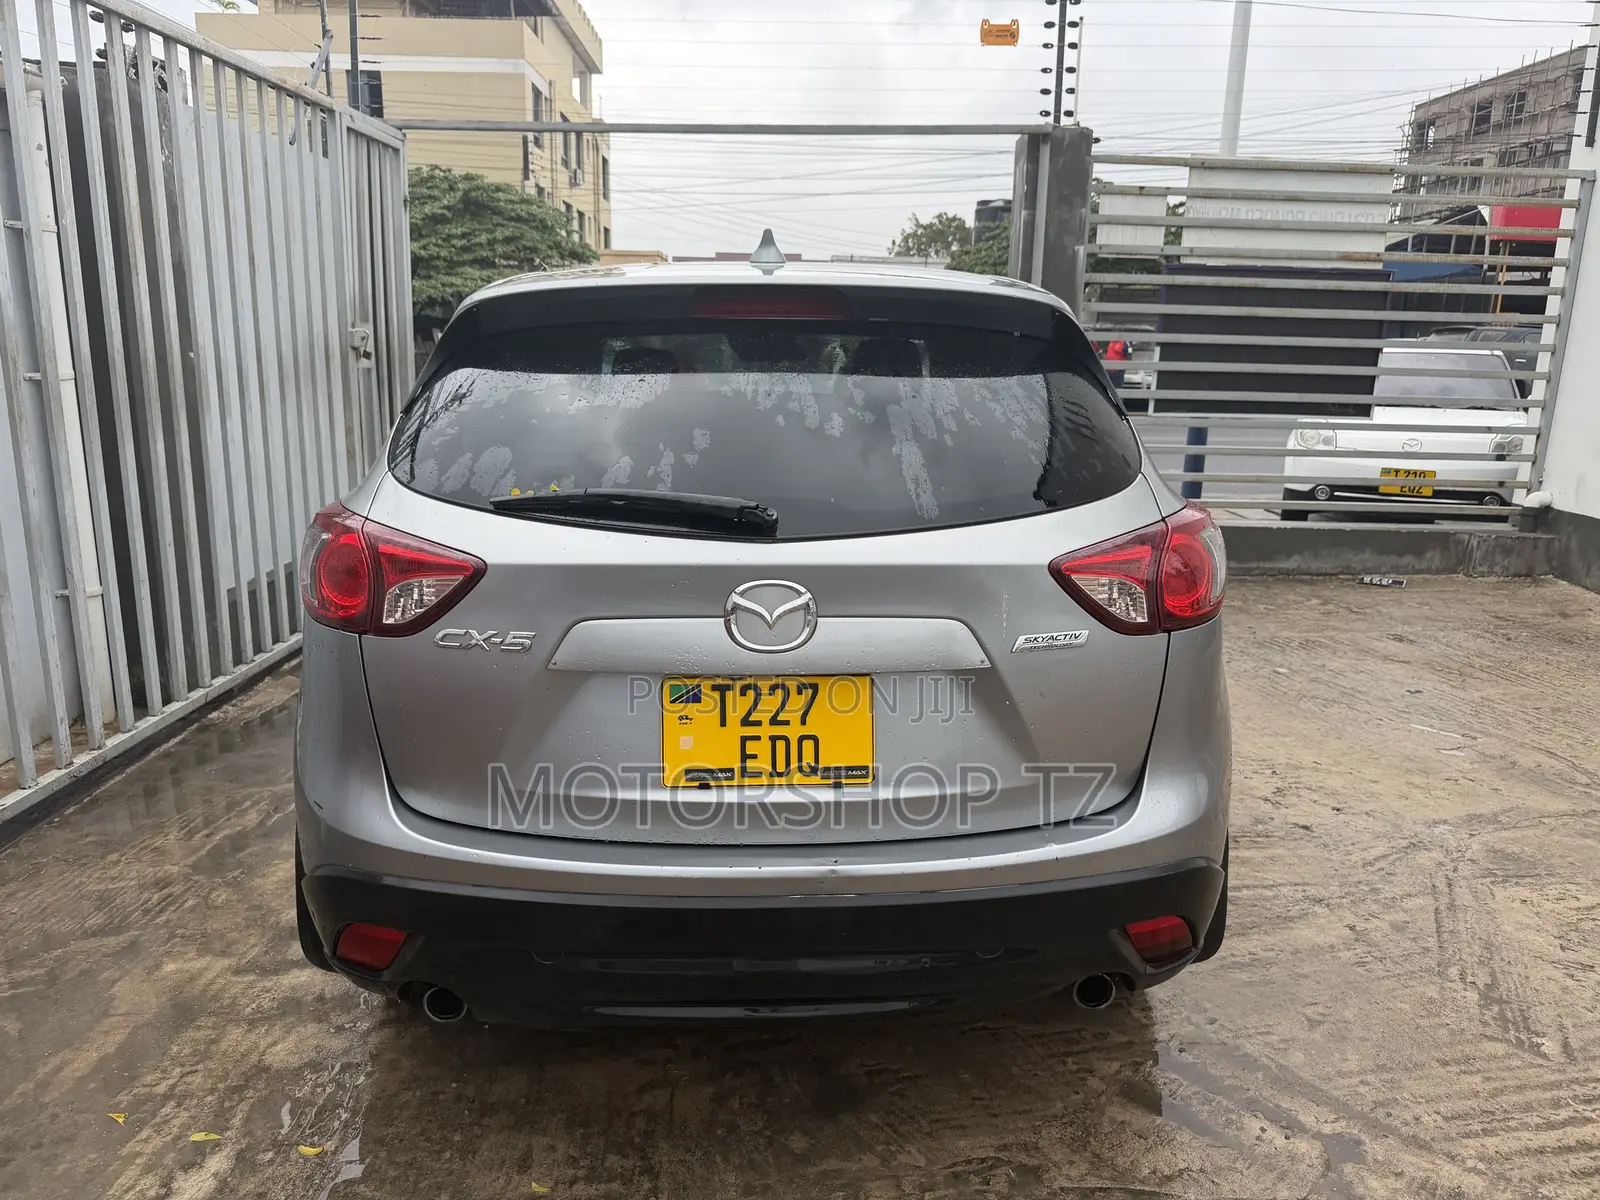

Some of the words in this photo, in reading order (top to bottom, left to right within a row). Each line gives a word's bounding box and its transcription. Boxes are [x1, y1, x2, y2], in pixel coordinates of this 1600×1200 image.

[433, 628, 537, 653] CX-5
[1023, 632, 1083, 644] SKYACTIV
[1029, 642, 1074, 651] TECHNOLOGY
[711, 683, 819, 727] T227
[739, 734, 820, 778] EDQ
